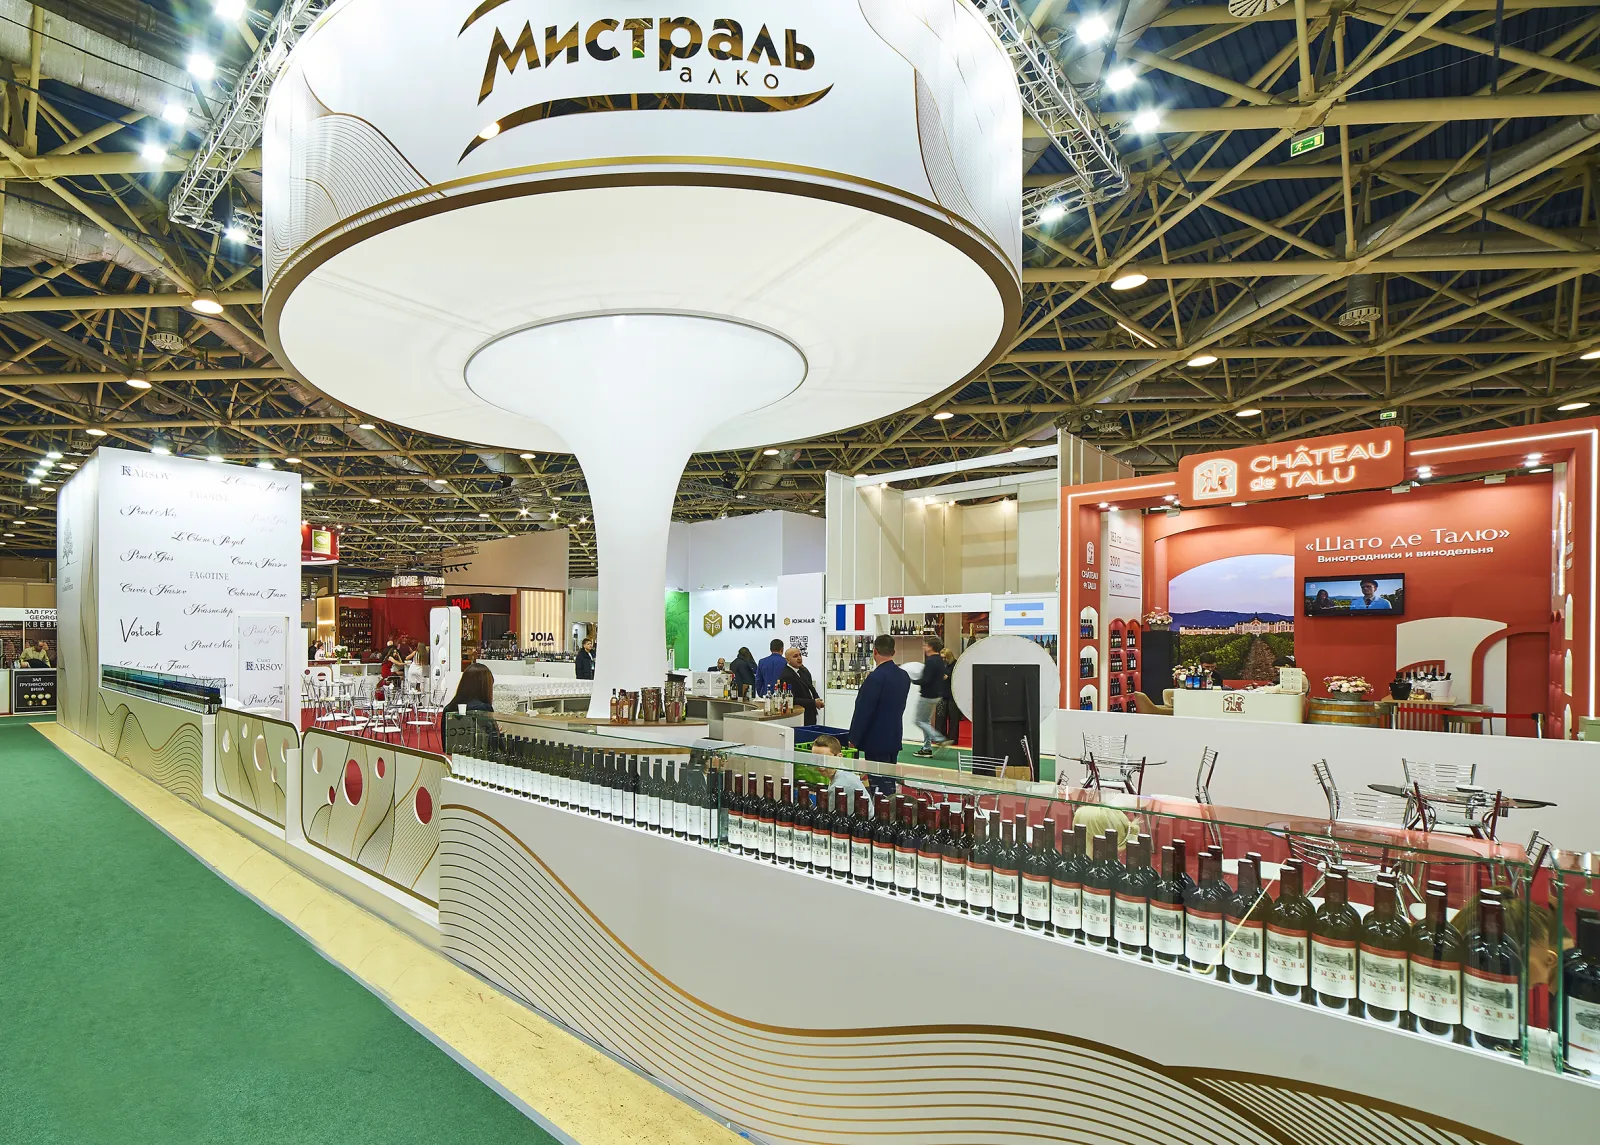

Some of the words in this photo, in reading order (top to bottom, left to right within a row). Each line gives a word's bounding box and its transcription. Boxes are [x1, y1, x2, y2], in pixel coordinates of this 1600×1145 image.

[477, 16, 815, 106] Мистраль
[1250, 440, 1391, 473] CHÂTEAU
[1250, 476, 1276, 491] de
[1280, 465, 1356, 489] TALU
[1305, 536, 1383, 552] «Шато
[1390, 533, 1422, 549] де
[1430, 527, 1510, 545] Талю»
[1317, 551, 1402, 563] Виноградники
[1416, 546, 1494, 558] винодельня
[189, 571, 230, 581] FAGOTINE
[119, 617, 163, 643] Vostock
[728, 613, 776, 629] ЮЖН
[530, 632, 555, 642] JOIA
[246, 661, 284, 671] KARSOV
